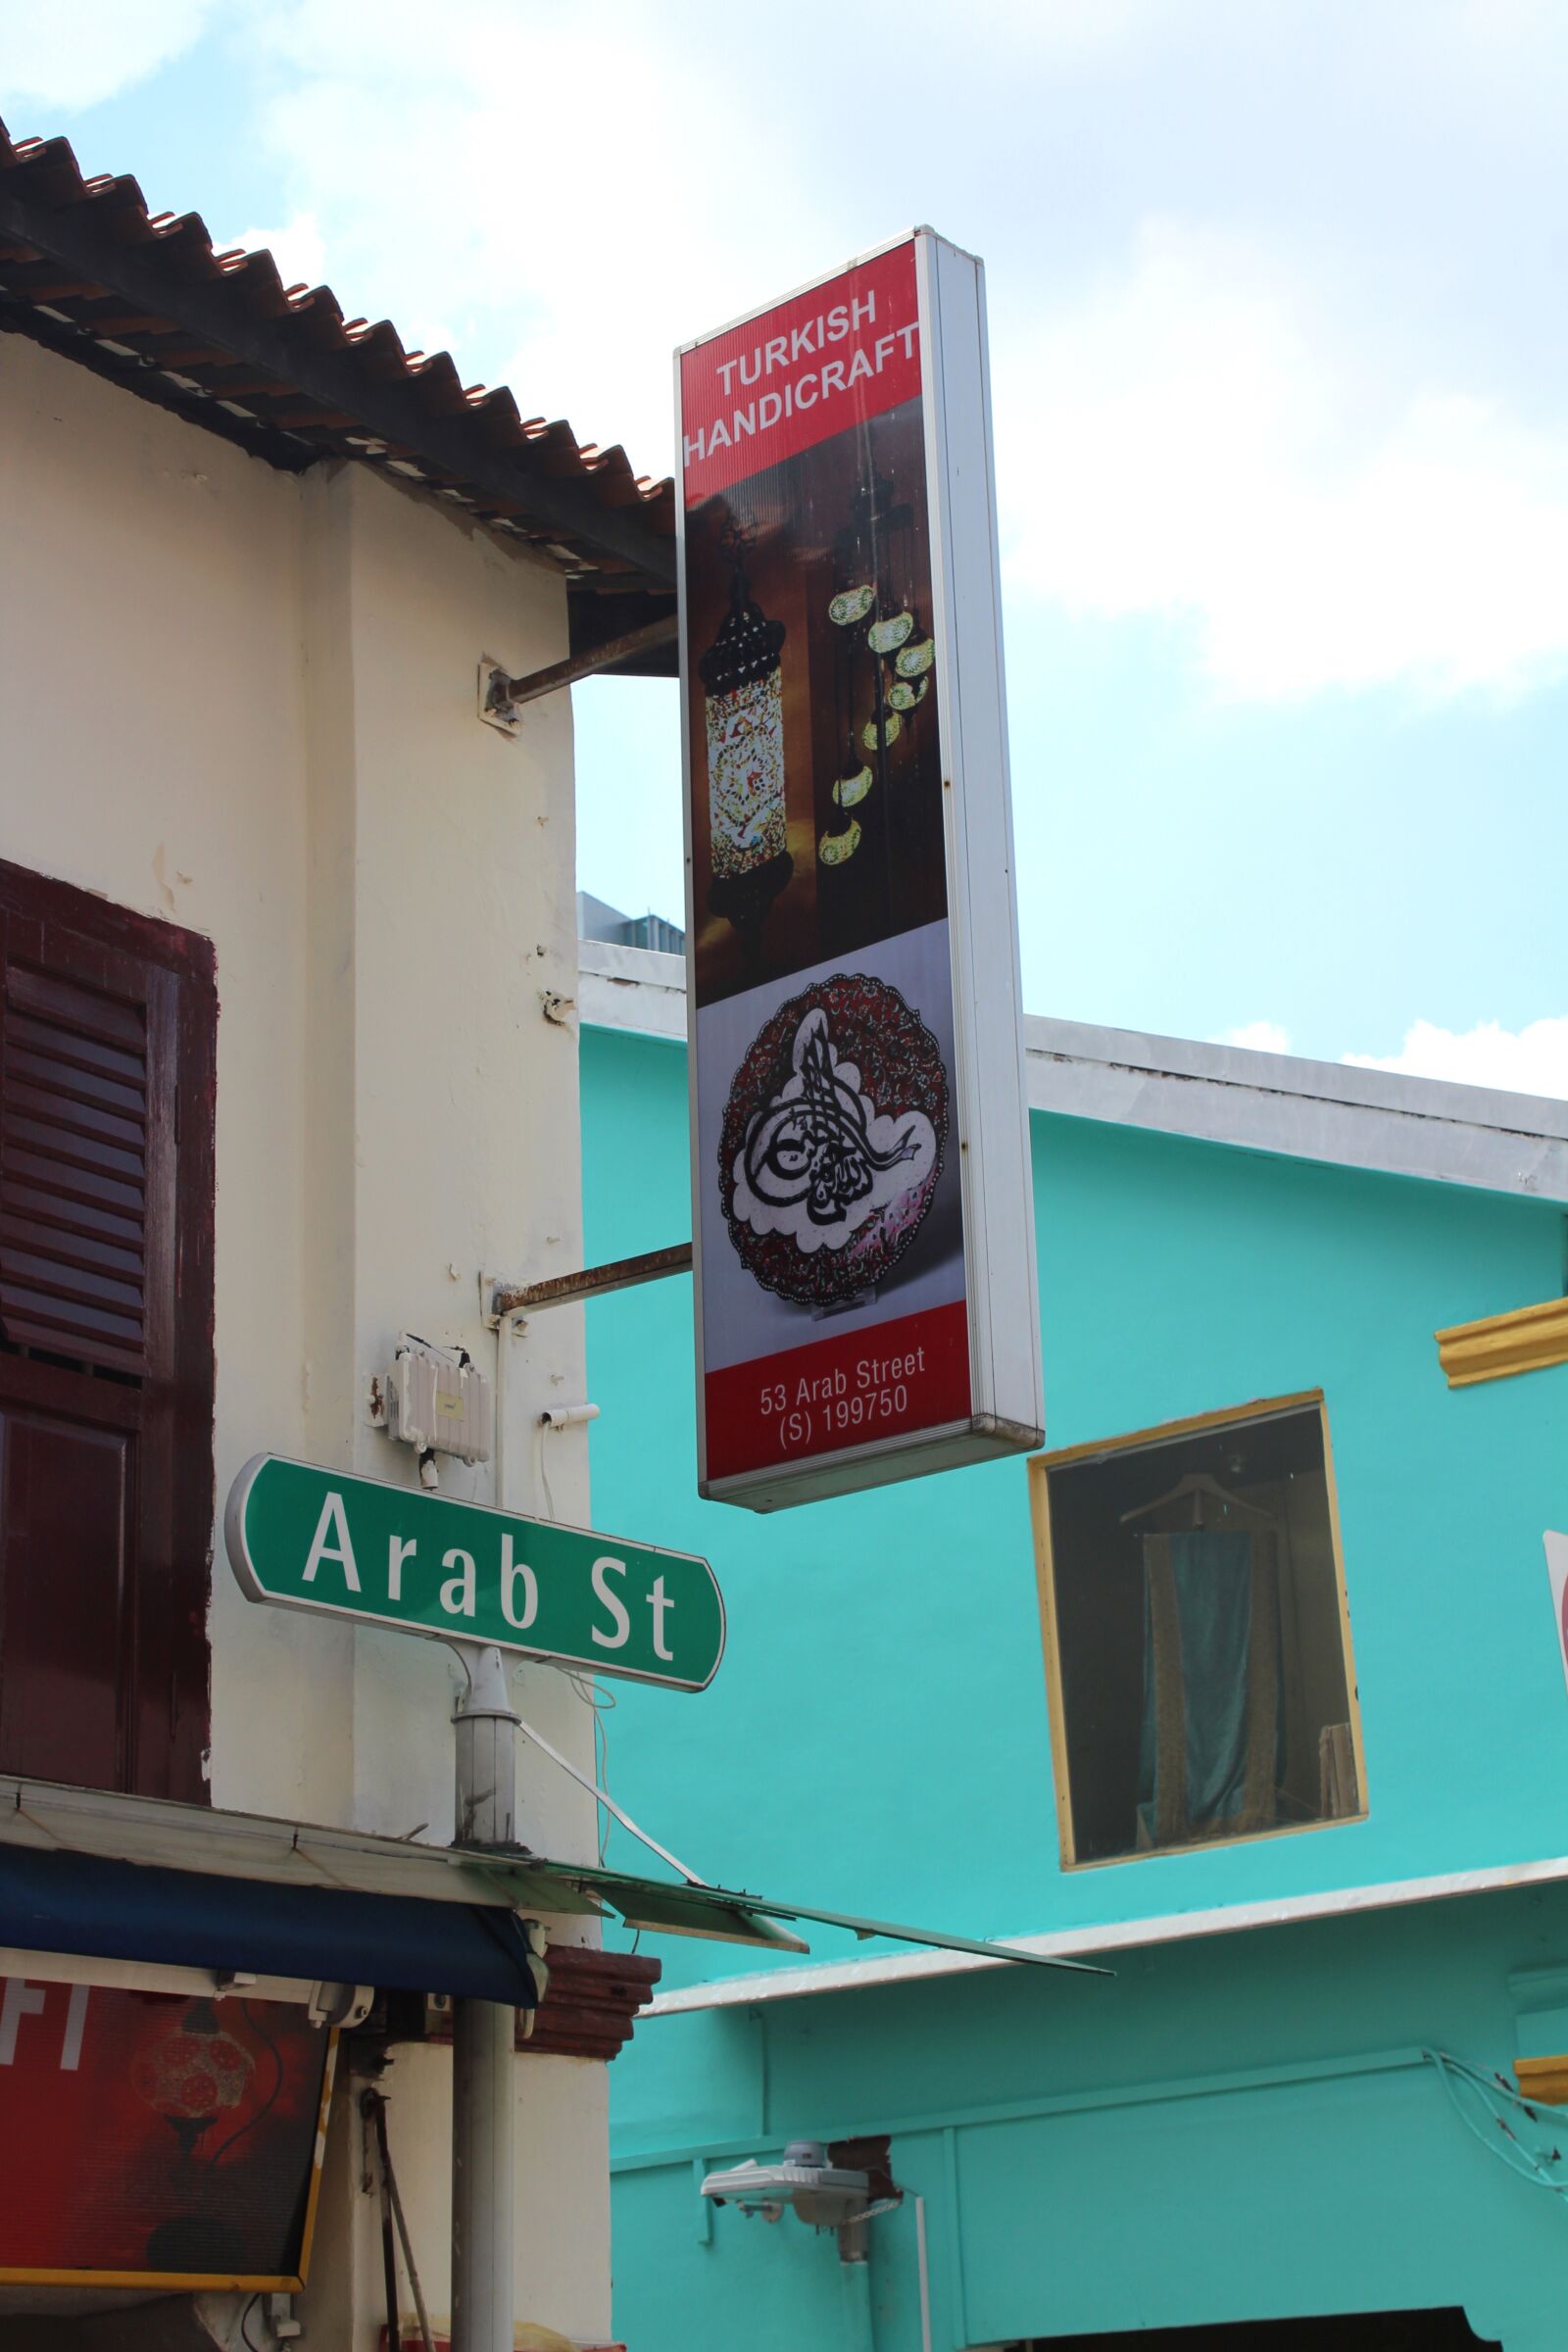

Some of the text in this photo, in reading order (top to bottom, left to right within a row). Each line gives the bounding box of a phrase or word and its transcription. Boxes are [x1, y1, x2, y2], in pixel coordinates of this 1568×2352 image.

[682, 320, 919, 467] HANDICRAFT
[715, 289, 876, 396] TURKISH
[760, 1347, 925, 1415] 53 Arab Street
[780, 1385, 907, 1449] (S) 199750
[301, 1491, 675, 1662] Arab St
